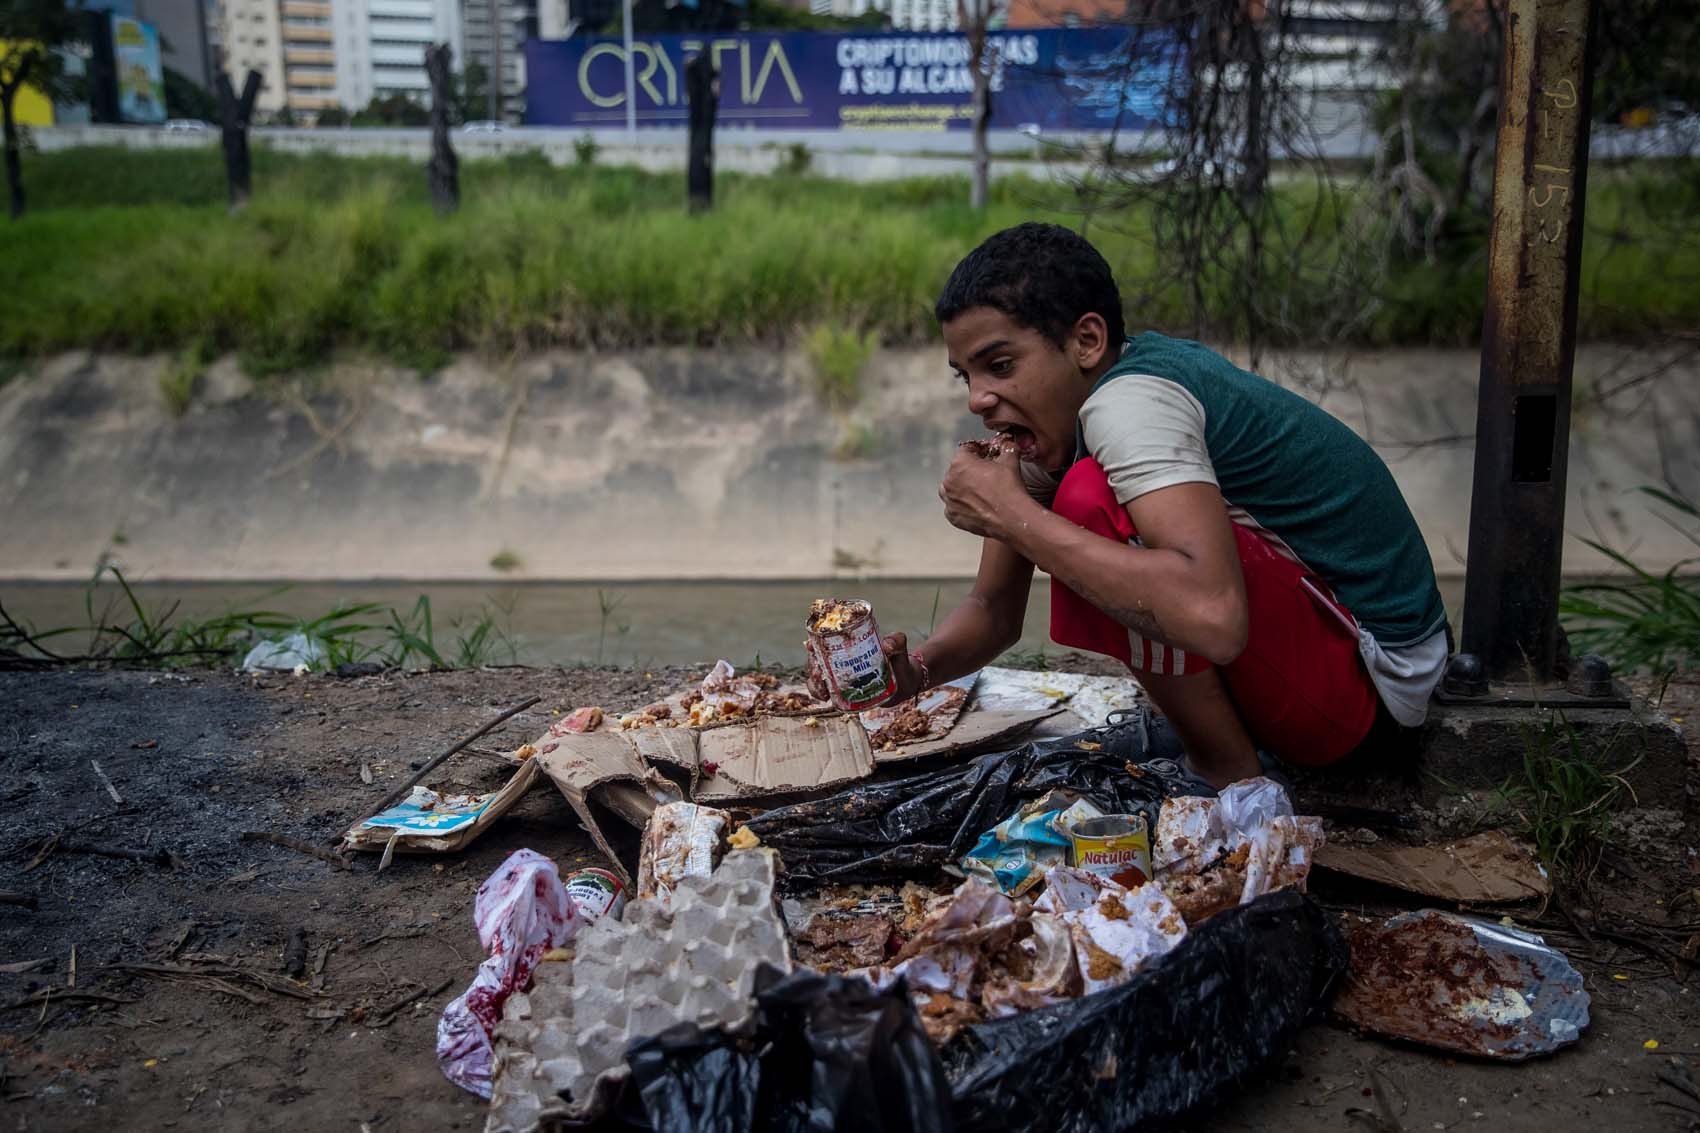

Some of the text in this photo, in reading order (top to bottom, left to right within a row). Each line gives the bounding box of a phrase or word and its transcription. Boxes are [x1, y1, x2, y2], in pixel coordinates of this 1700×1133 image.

[837, 35, 1038, 67] CRIPTOMONDAS
[840, 65, 1004, 94] A SU ALCANE
[833, 645, 879, 668] Evaporated
[852, 660, 872, 673] Milk
[1084, 849, 1137, 865] Natulac
